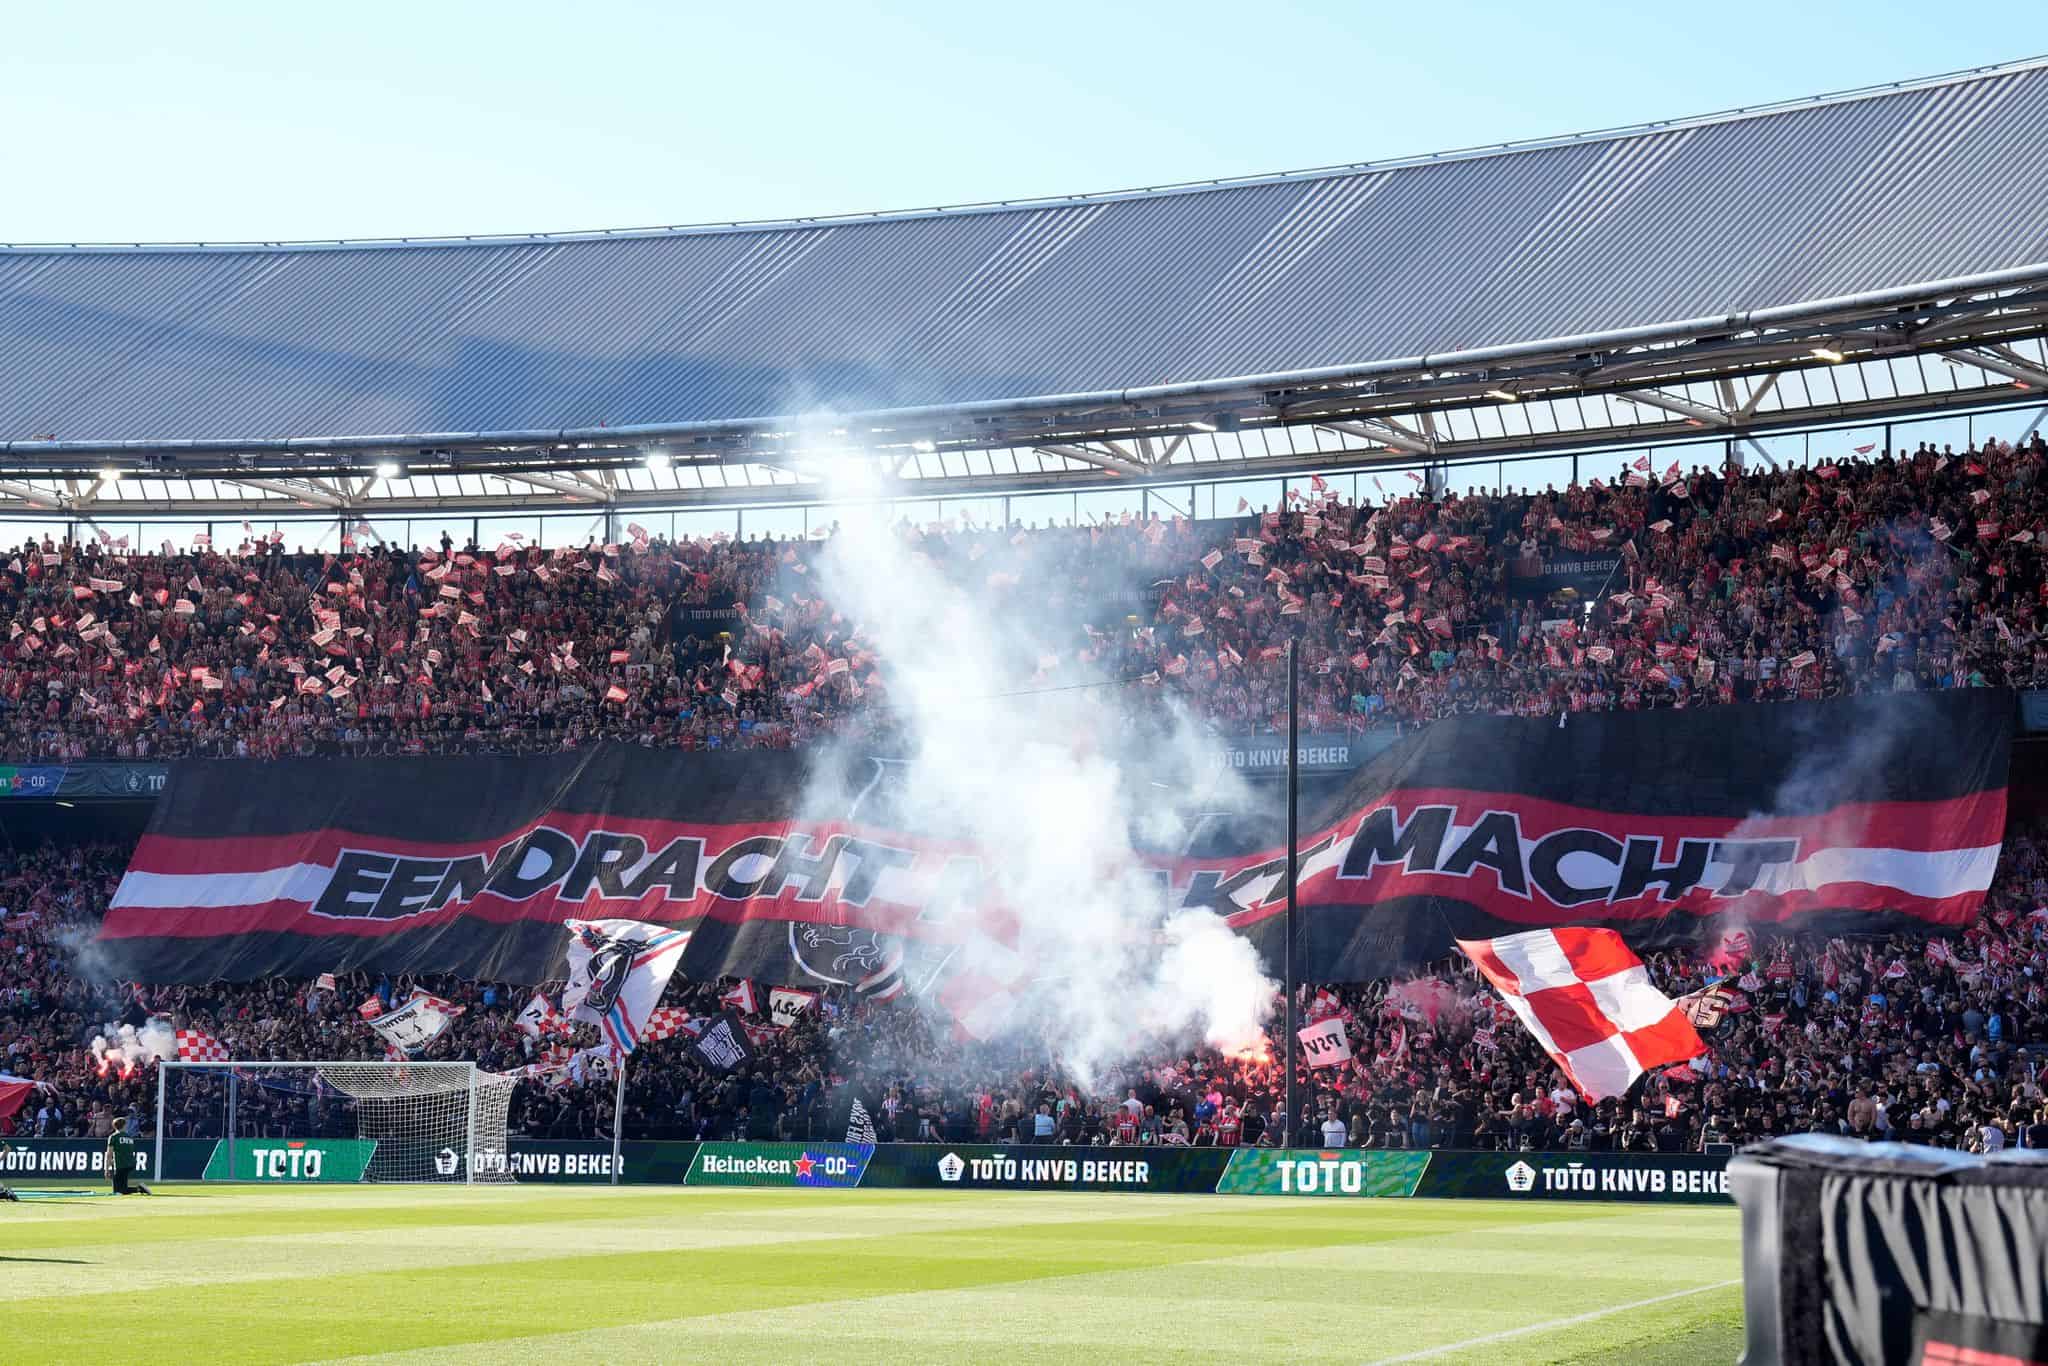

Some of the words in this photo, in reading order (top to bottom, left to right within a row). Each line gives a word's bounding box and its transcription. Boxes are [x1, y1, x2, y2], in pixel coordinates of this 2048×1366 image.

[1297, 747, 1349, 764] BEKER
[308, 825, 914, 921] EENDRACHT
[1337, 805, 1800, 907] MACHT
[40, 1152, 87, 1170] KNVB
[253, 1149, 322, 1177] TOTO
[703, 1155, 791, 1174] Heineken
[970, 1157, 1017, 1180] TOTO
[1022, 1159, 1077, 1182] KNVB
[1083, 1161, 1149, 1183] BEKER
[1277, 1160, 1362, 1192] TOTO
[1543, 1166, 1596, 1191] TOTO
[1602, 1168, 1666, 1192] KNVB
